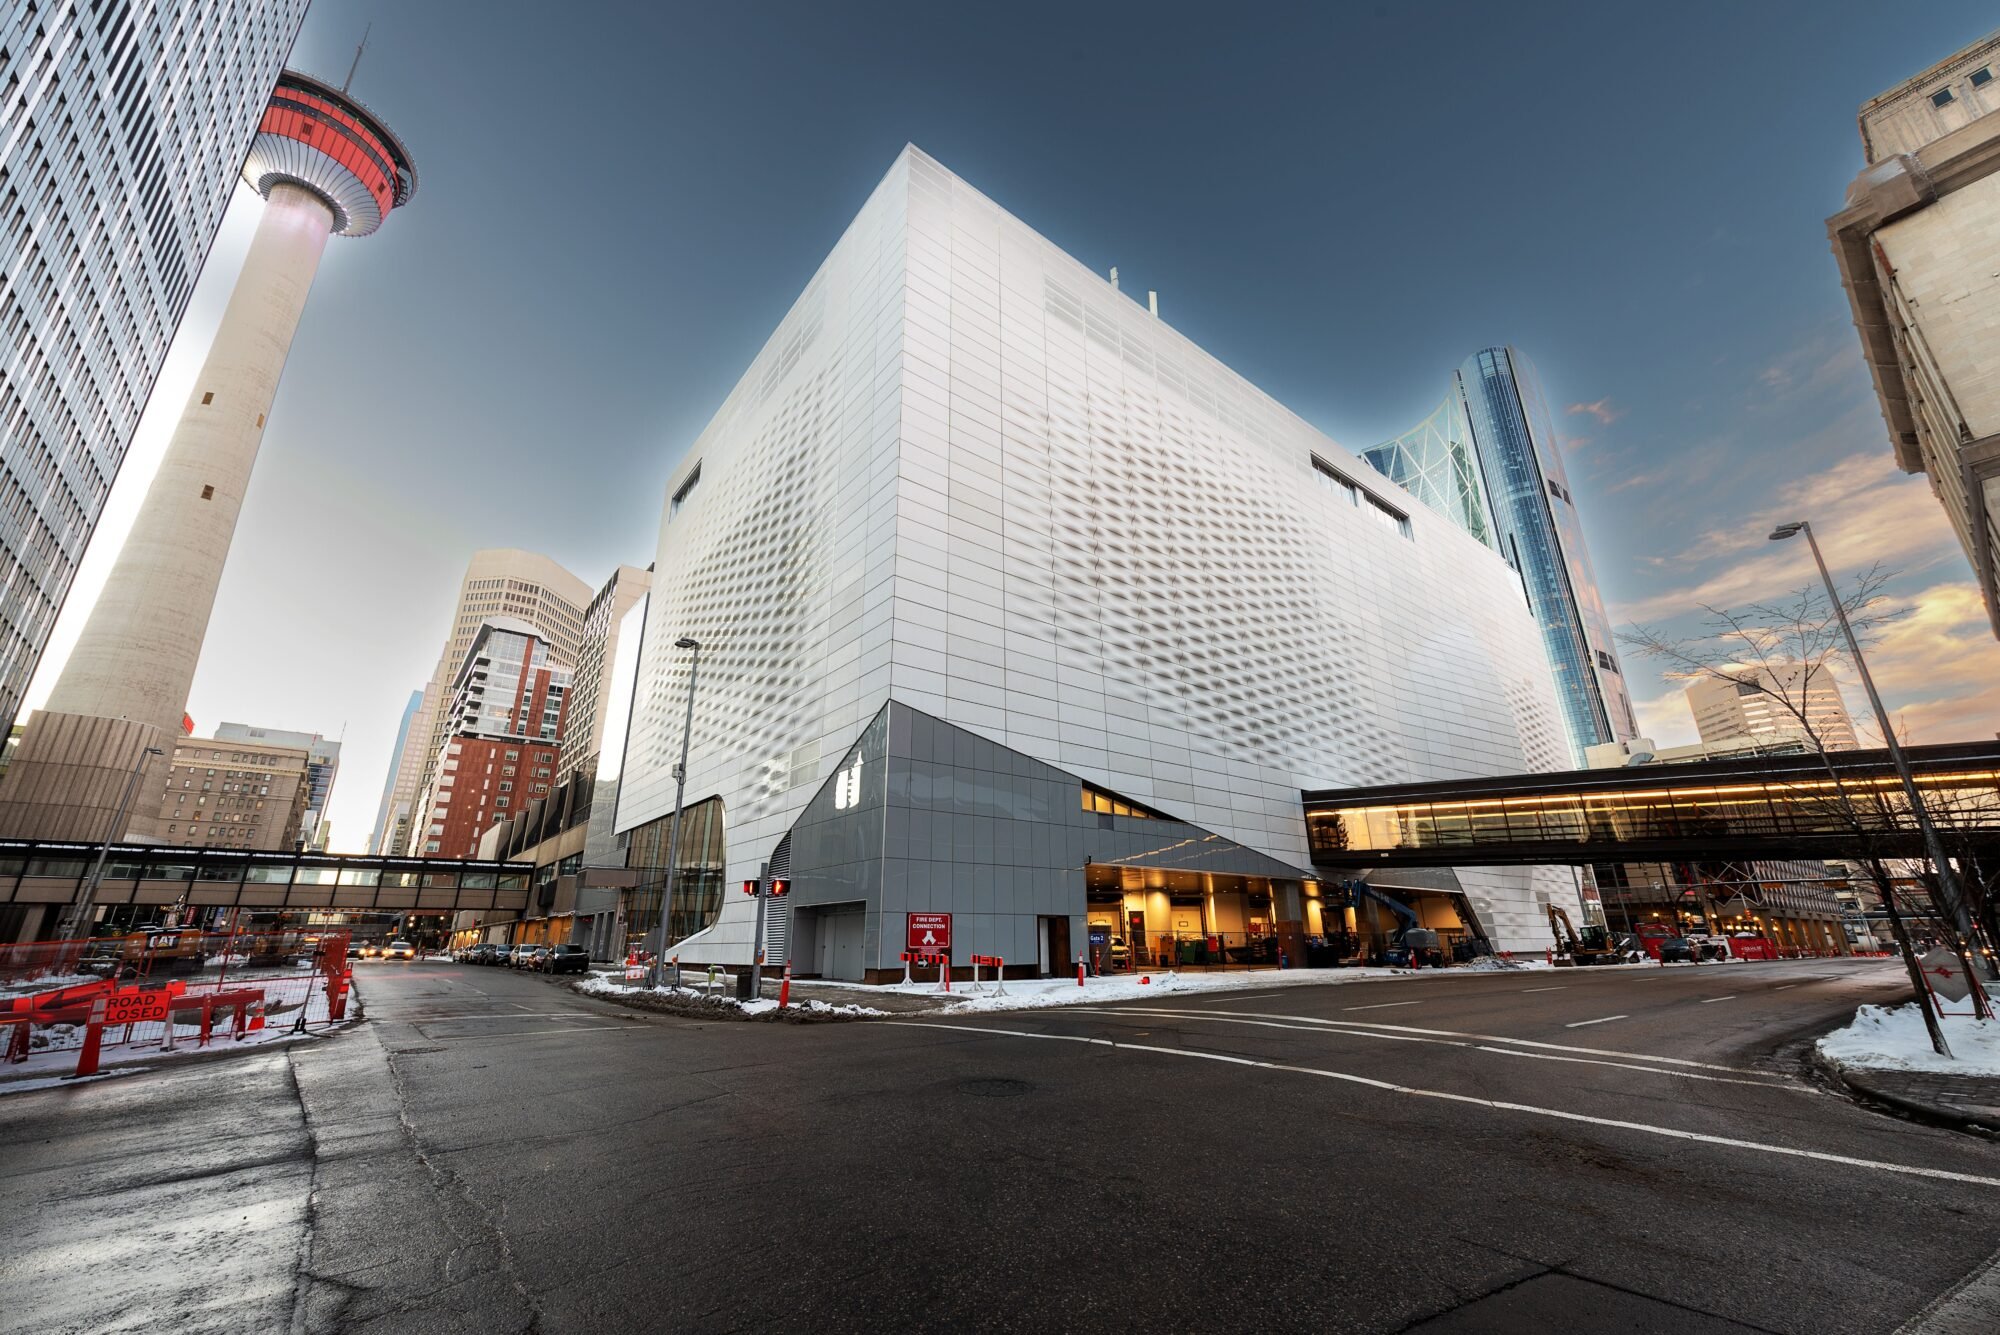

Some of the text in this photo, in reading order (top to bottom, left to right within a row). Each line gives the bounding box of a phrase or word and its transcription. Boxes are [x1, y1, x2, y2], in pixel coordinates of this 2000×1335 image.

[149, 935, 176, 948] CAT
[107, 995, 156, 1009] ROAD
[105, 1006, 164, 1021] LOSED
